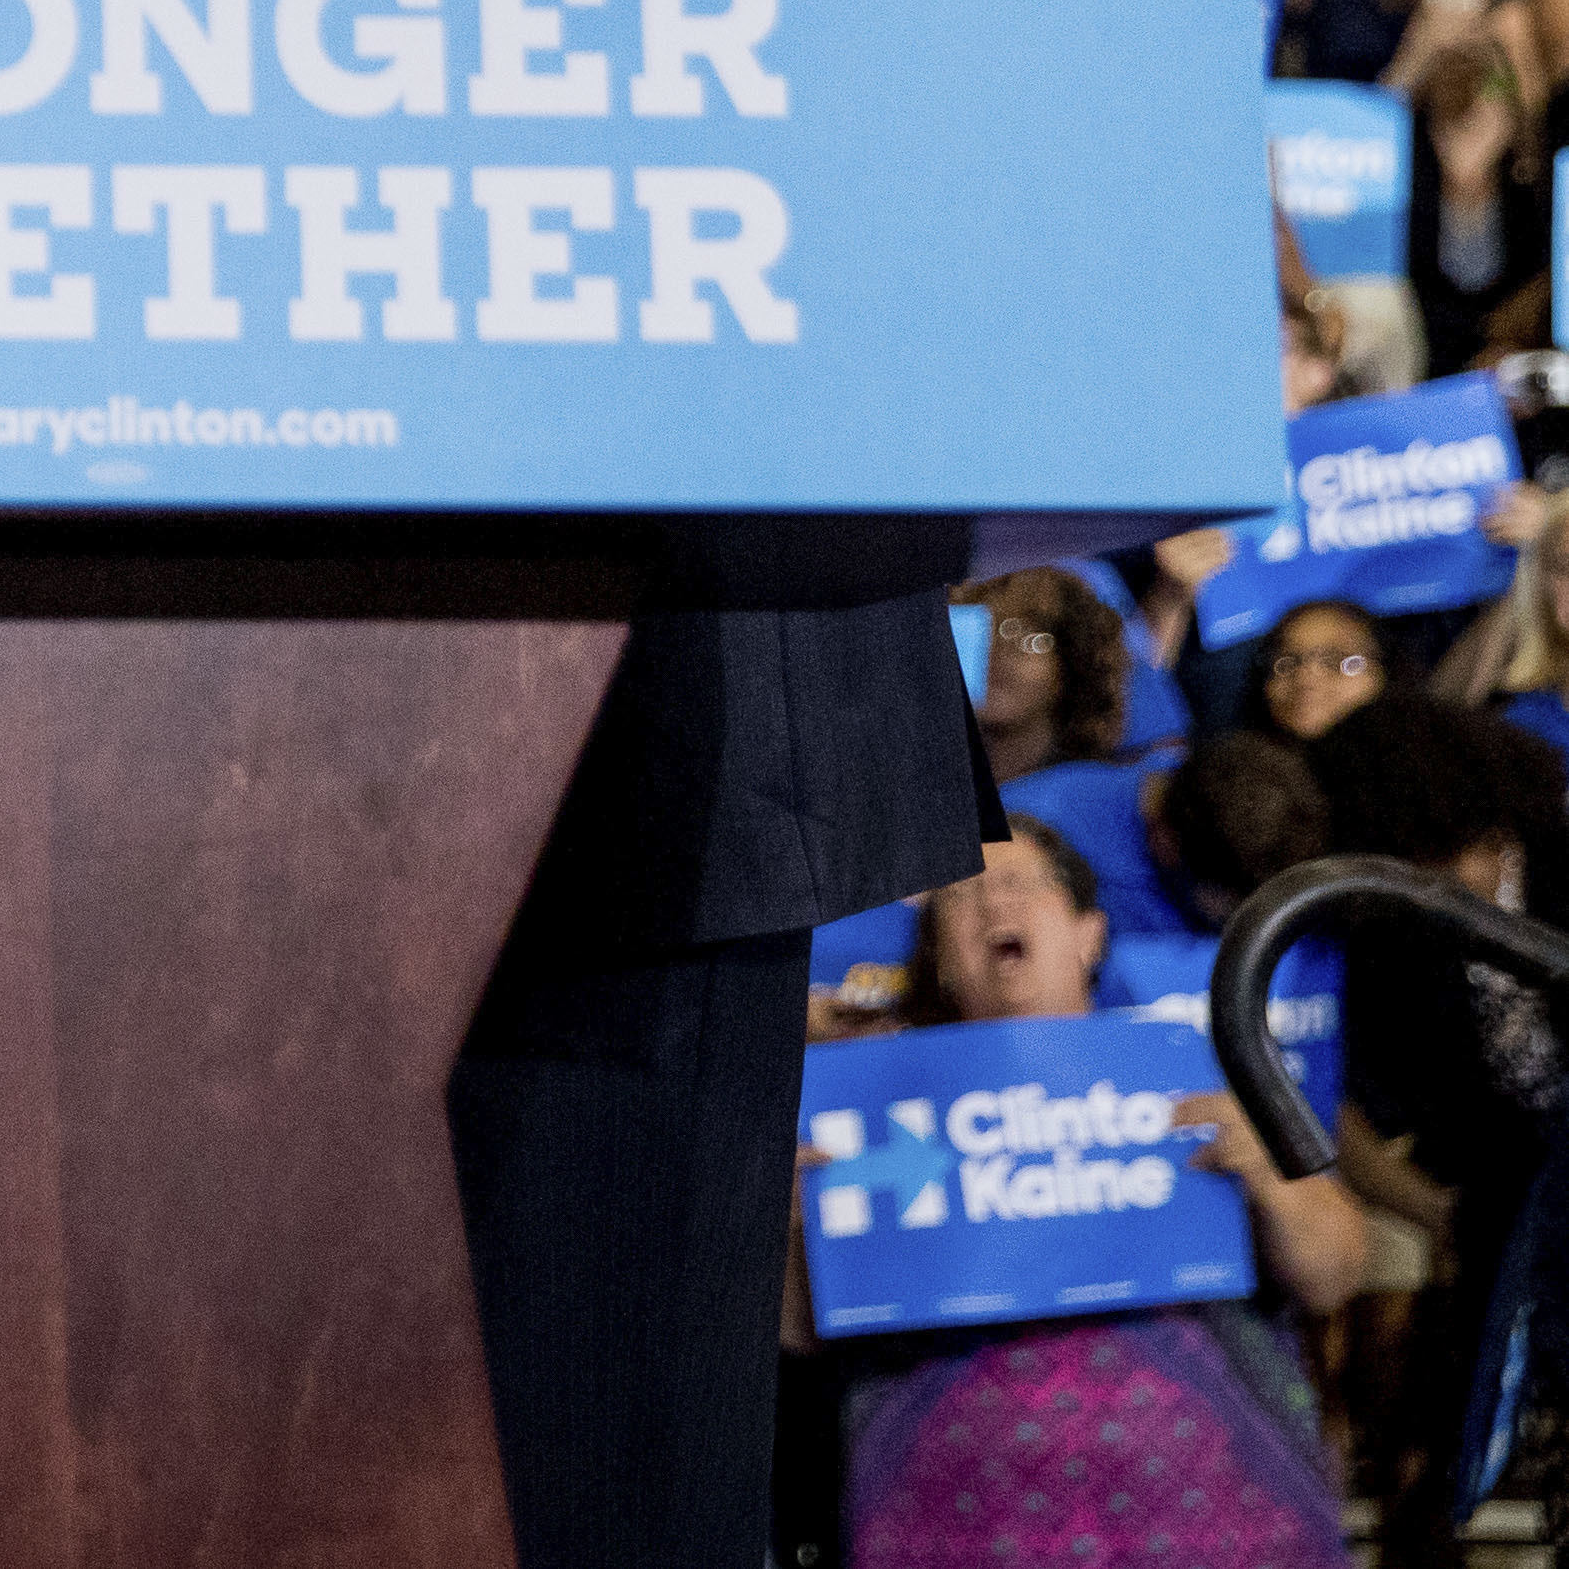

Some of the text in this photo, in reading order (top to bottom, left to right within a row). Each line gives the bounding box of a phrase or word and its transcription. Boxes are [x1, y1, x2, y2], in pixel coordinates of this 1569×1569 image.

[1298, 434, 1508, 503] Clinton
[1306, 489, 1477, 553] Kaine
[946, 1079, 1178, 1155] Clinto
[960, 1153, 1177, 1223] Kaine
